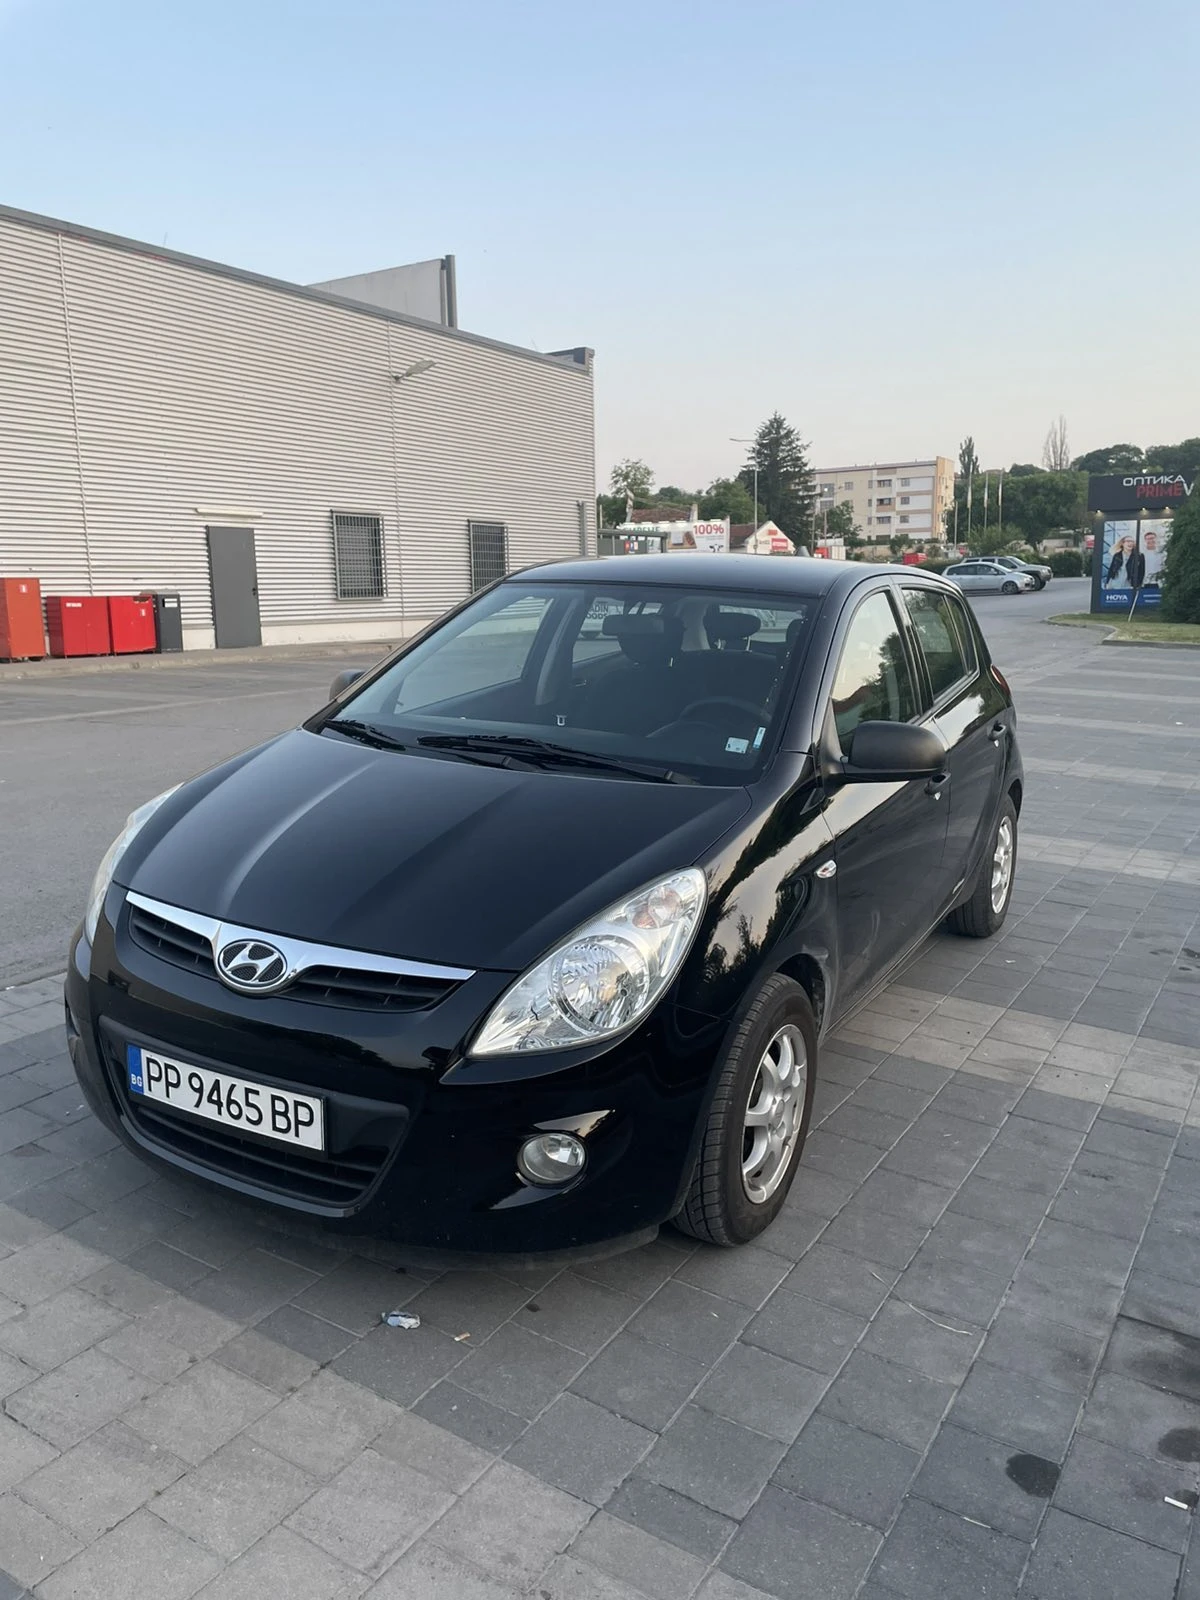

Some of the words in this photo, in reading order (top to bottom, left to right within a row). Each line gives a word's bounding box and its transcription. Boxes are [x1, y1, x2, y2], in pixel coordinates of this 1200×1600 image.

[1123, 475, 1185, 487] ОПТИКА
[1136, 482, 1182, 497] PRIME
[693, 524, 724, 535] 100%
[130, 1073, 143, 1087] BG
[188, 1072, 263, 1125] 9465
